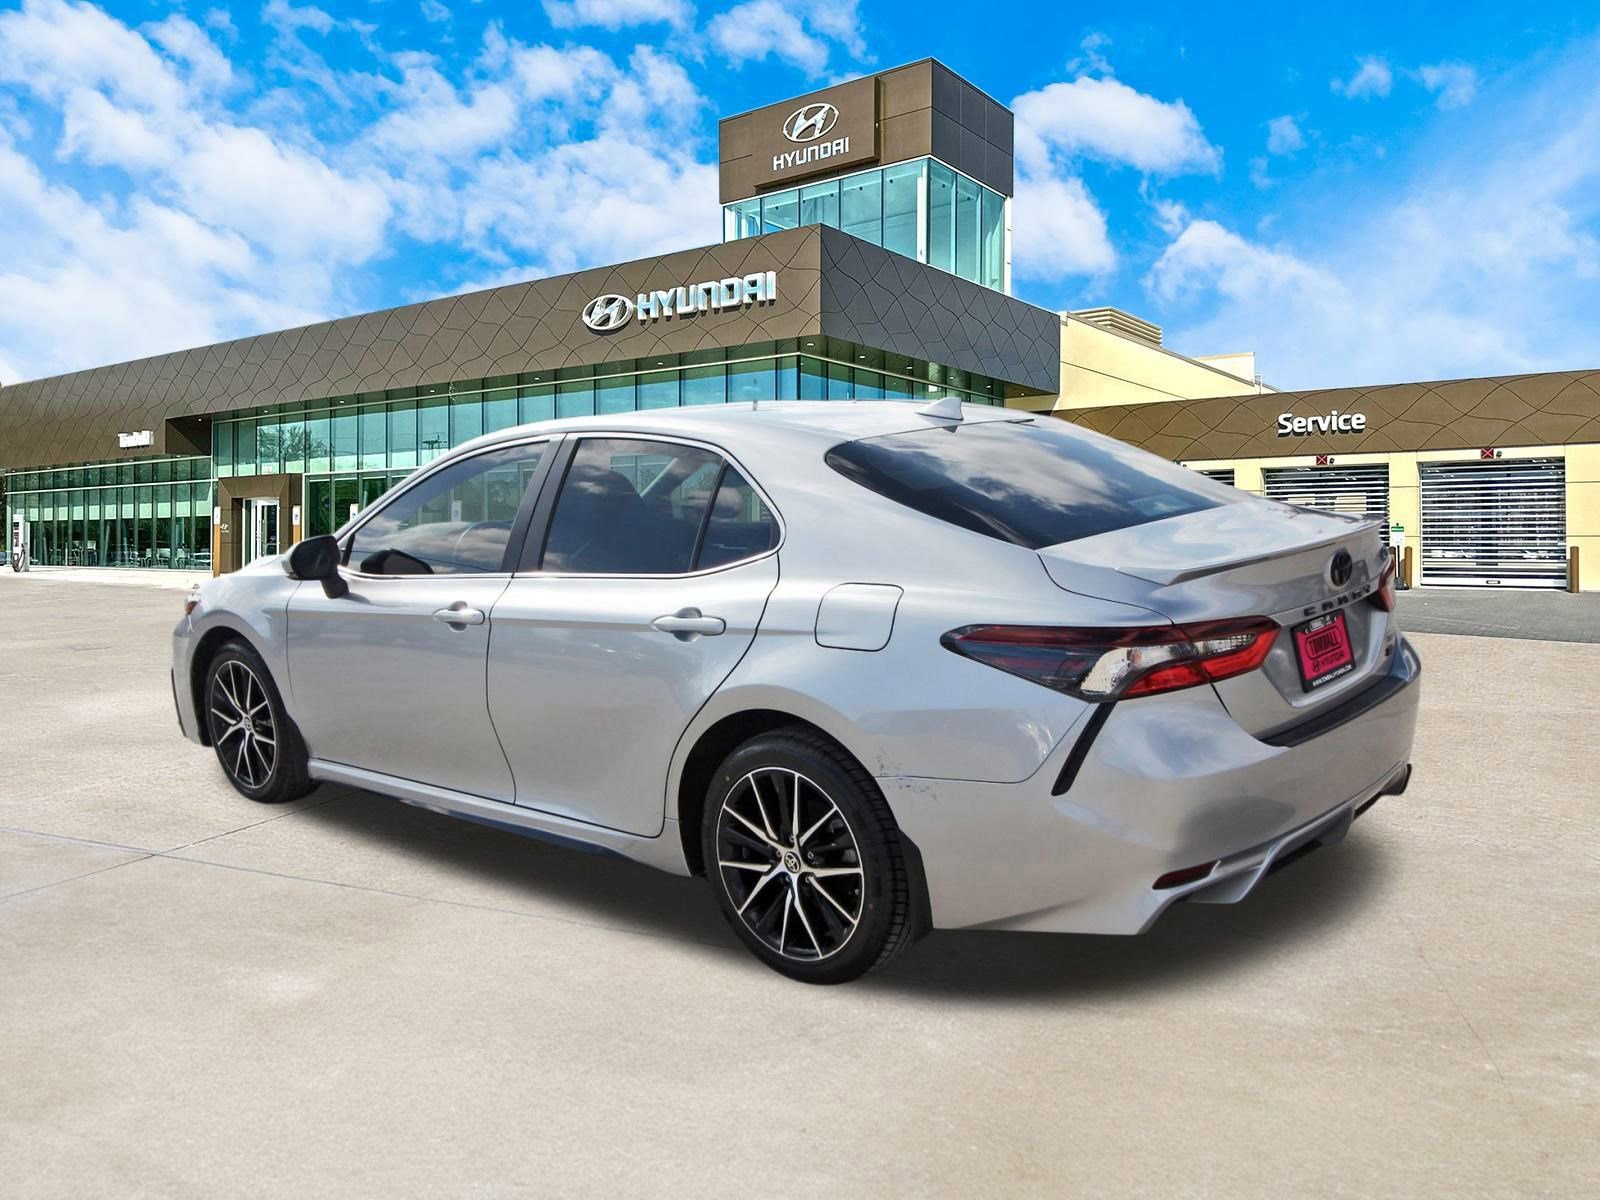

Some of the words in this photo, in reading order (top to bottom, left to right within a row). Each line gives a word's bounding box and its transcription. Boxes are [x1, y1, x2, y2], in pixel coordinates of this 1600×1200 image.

[773, 136, 850, 172] HYUNDAI
[637, 270, 777, 321] HYUNDAI
[1277, 410, 1367, 435] Service
